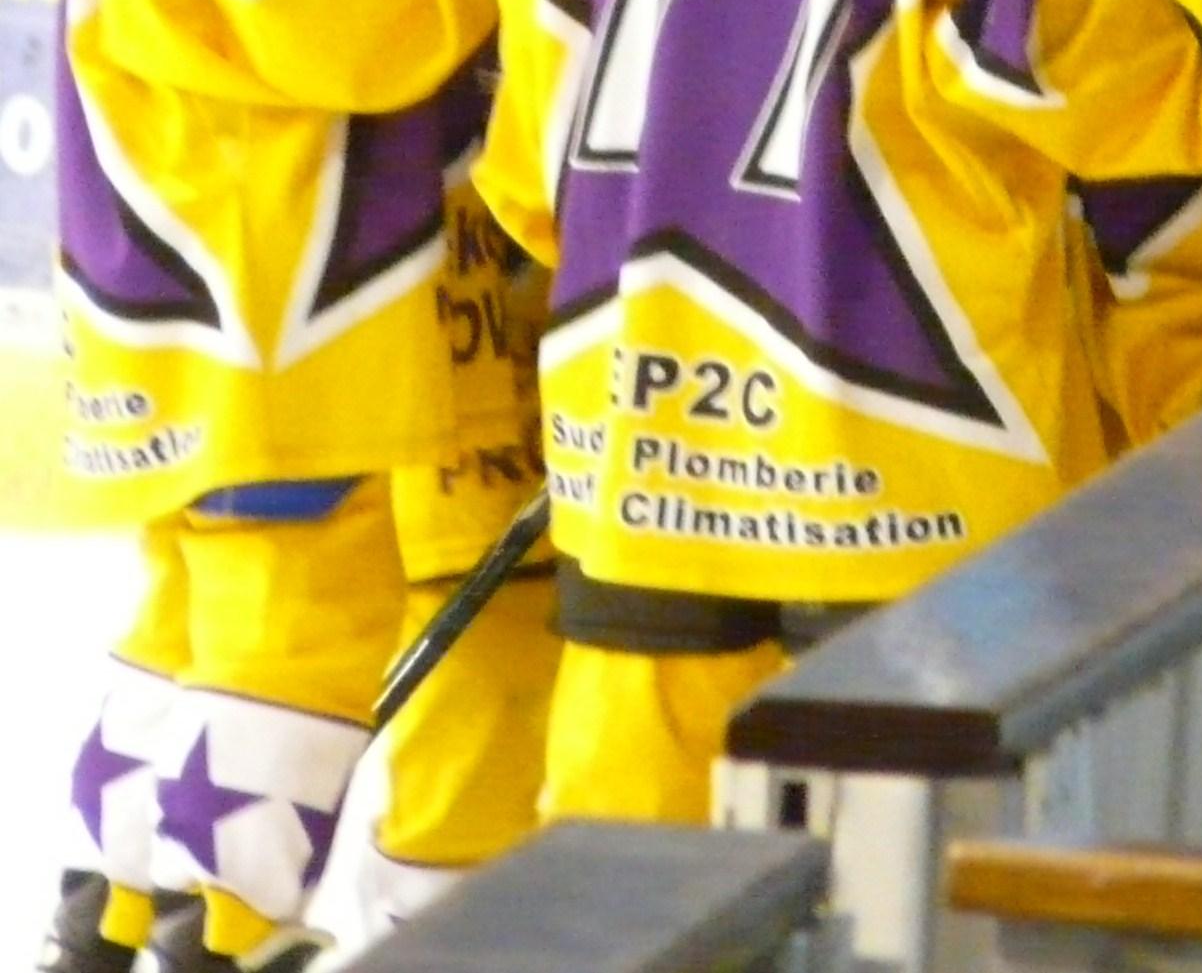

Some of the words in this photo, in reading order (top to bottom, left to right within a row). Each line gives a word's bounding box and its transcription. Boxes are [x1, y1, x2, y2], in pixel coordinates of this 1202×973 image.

[612, 350, 778, 428] P2C
[633, 437, 880, 499] Plomberie
[619, 492, 966, 548] Climatisation
